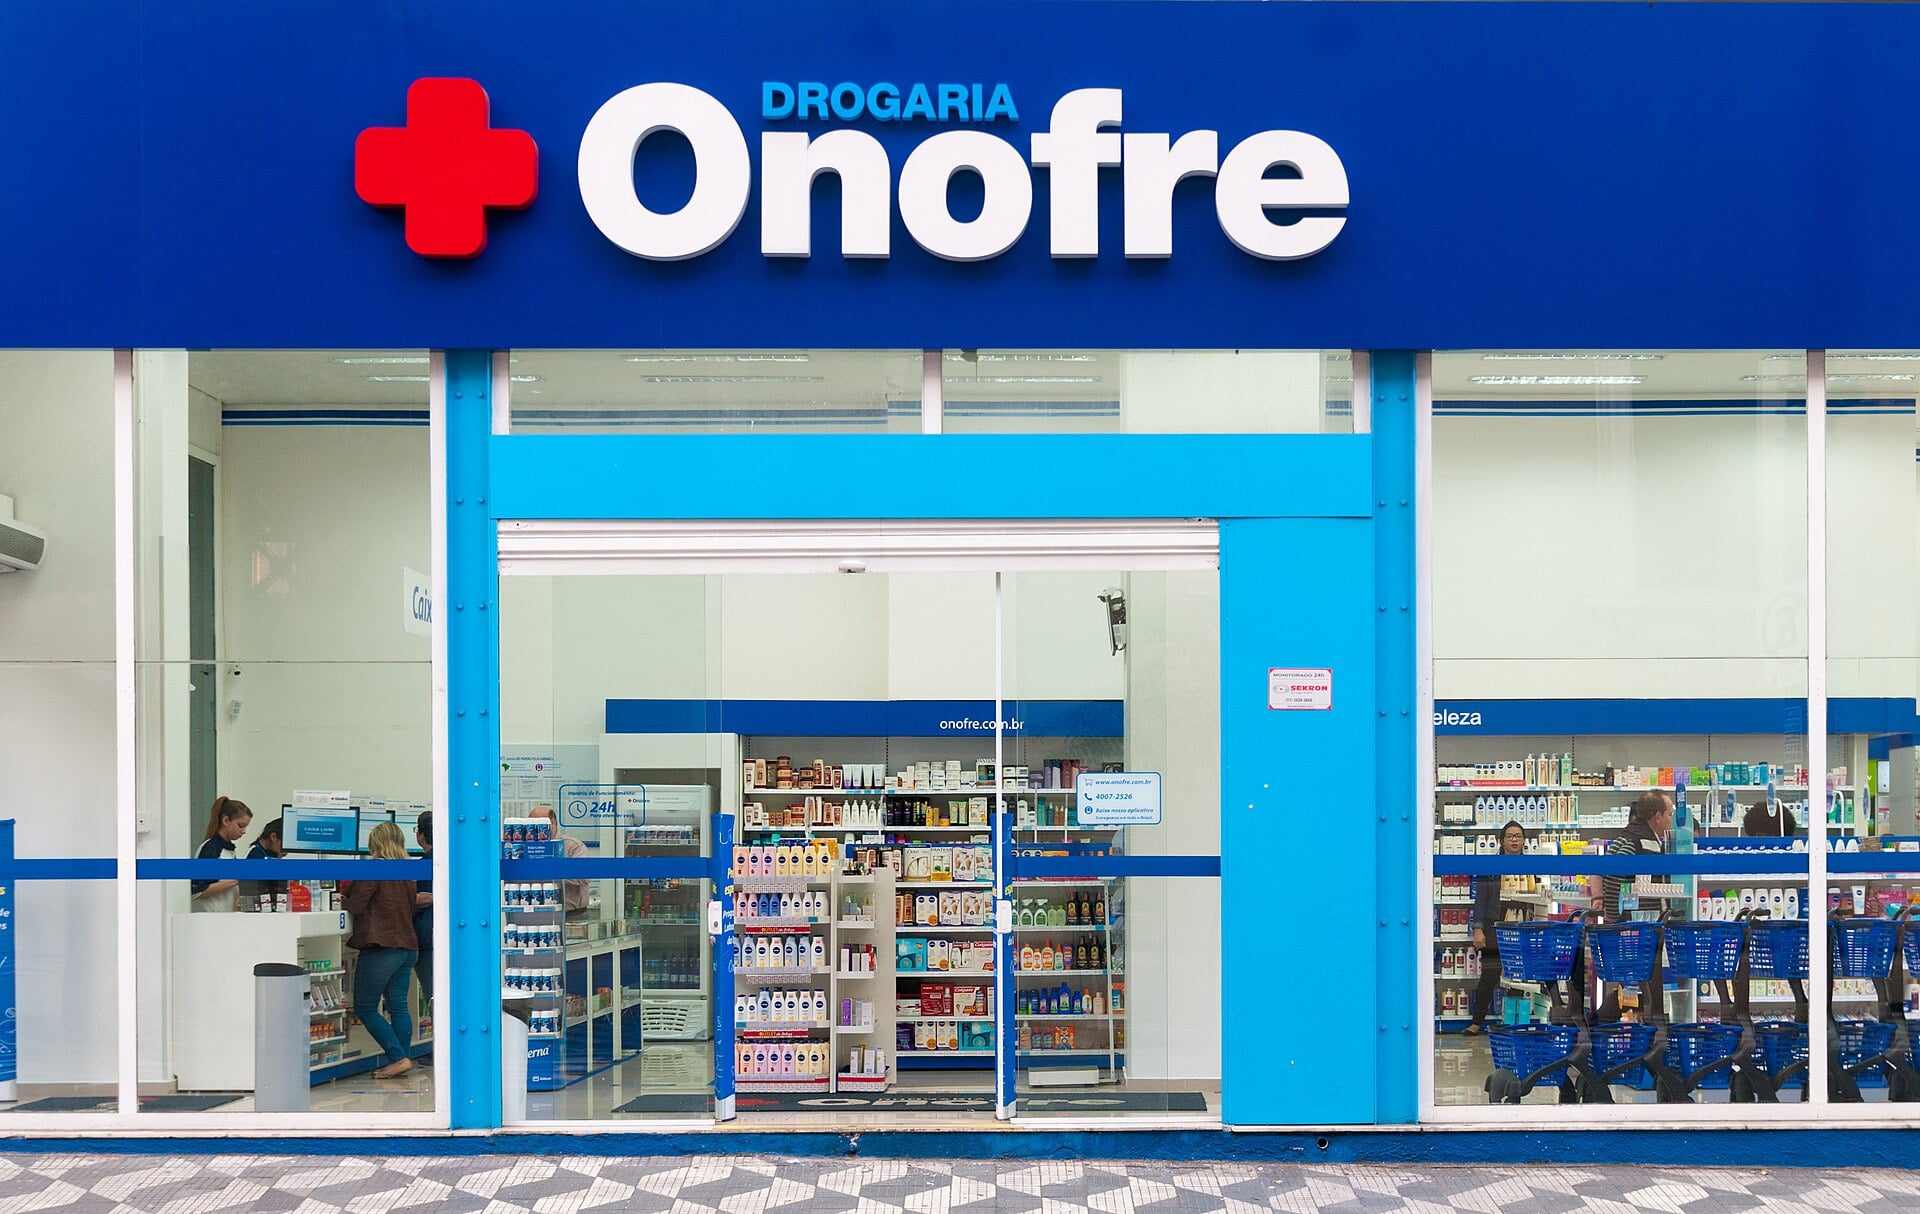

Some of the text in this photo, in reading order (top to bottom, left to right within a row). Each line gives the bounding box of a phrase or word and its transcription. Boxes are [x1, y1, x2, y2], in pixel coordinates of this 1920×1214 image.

[761, 81, 1020, 122] DROGARIA
[577, 82, 1350, 262] Onofre
[939, 717, 1025, 730] onofre.com.br
[1095, 792, 1133, 800] 4007-2526
[589, 800, 616, 813] 24h
